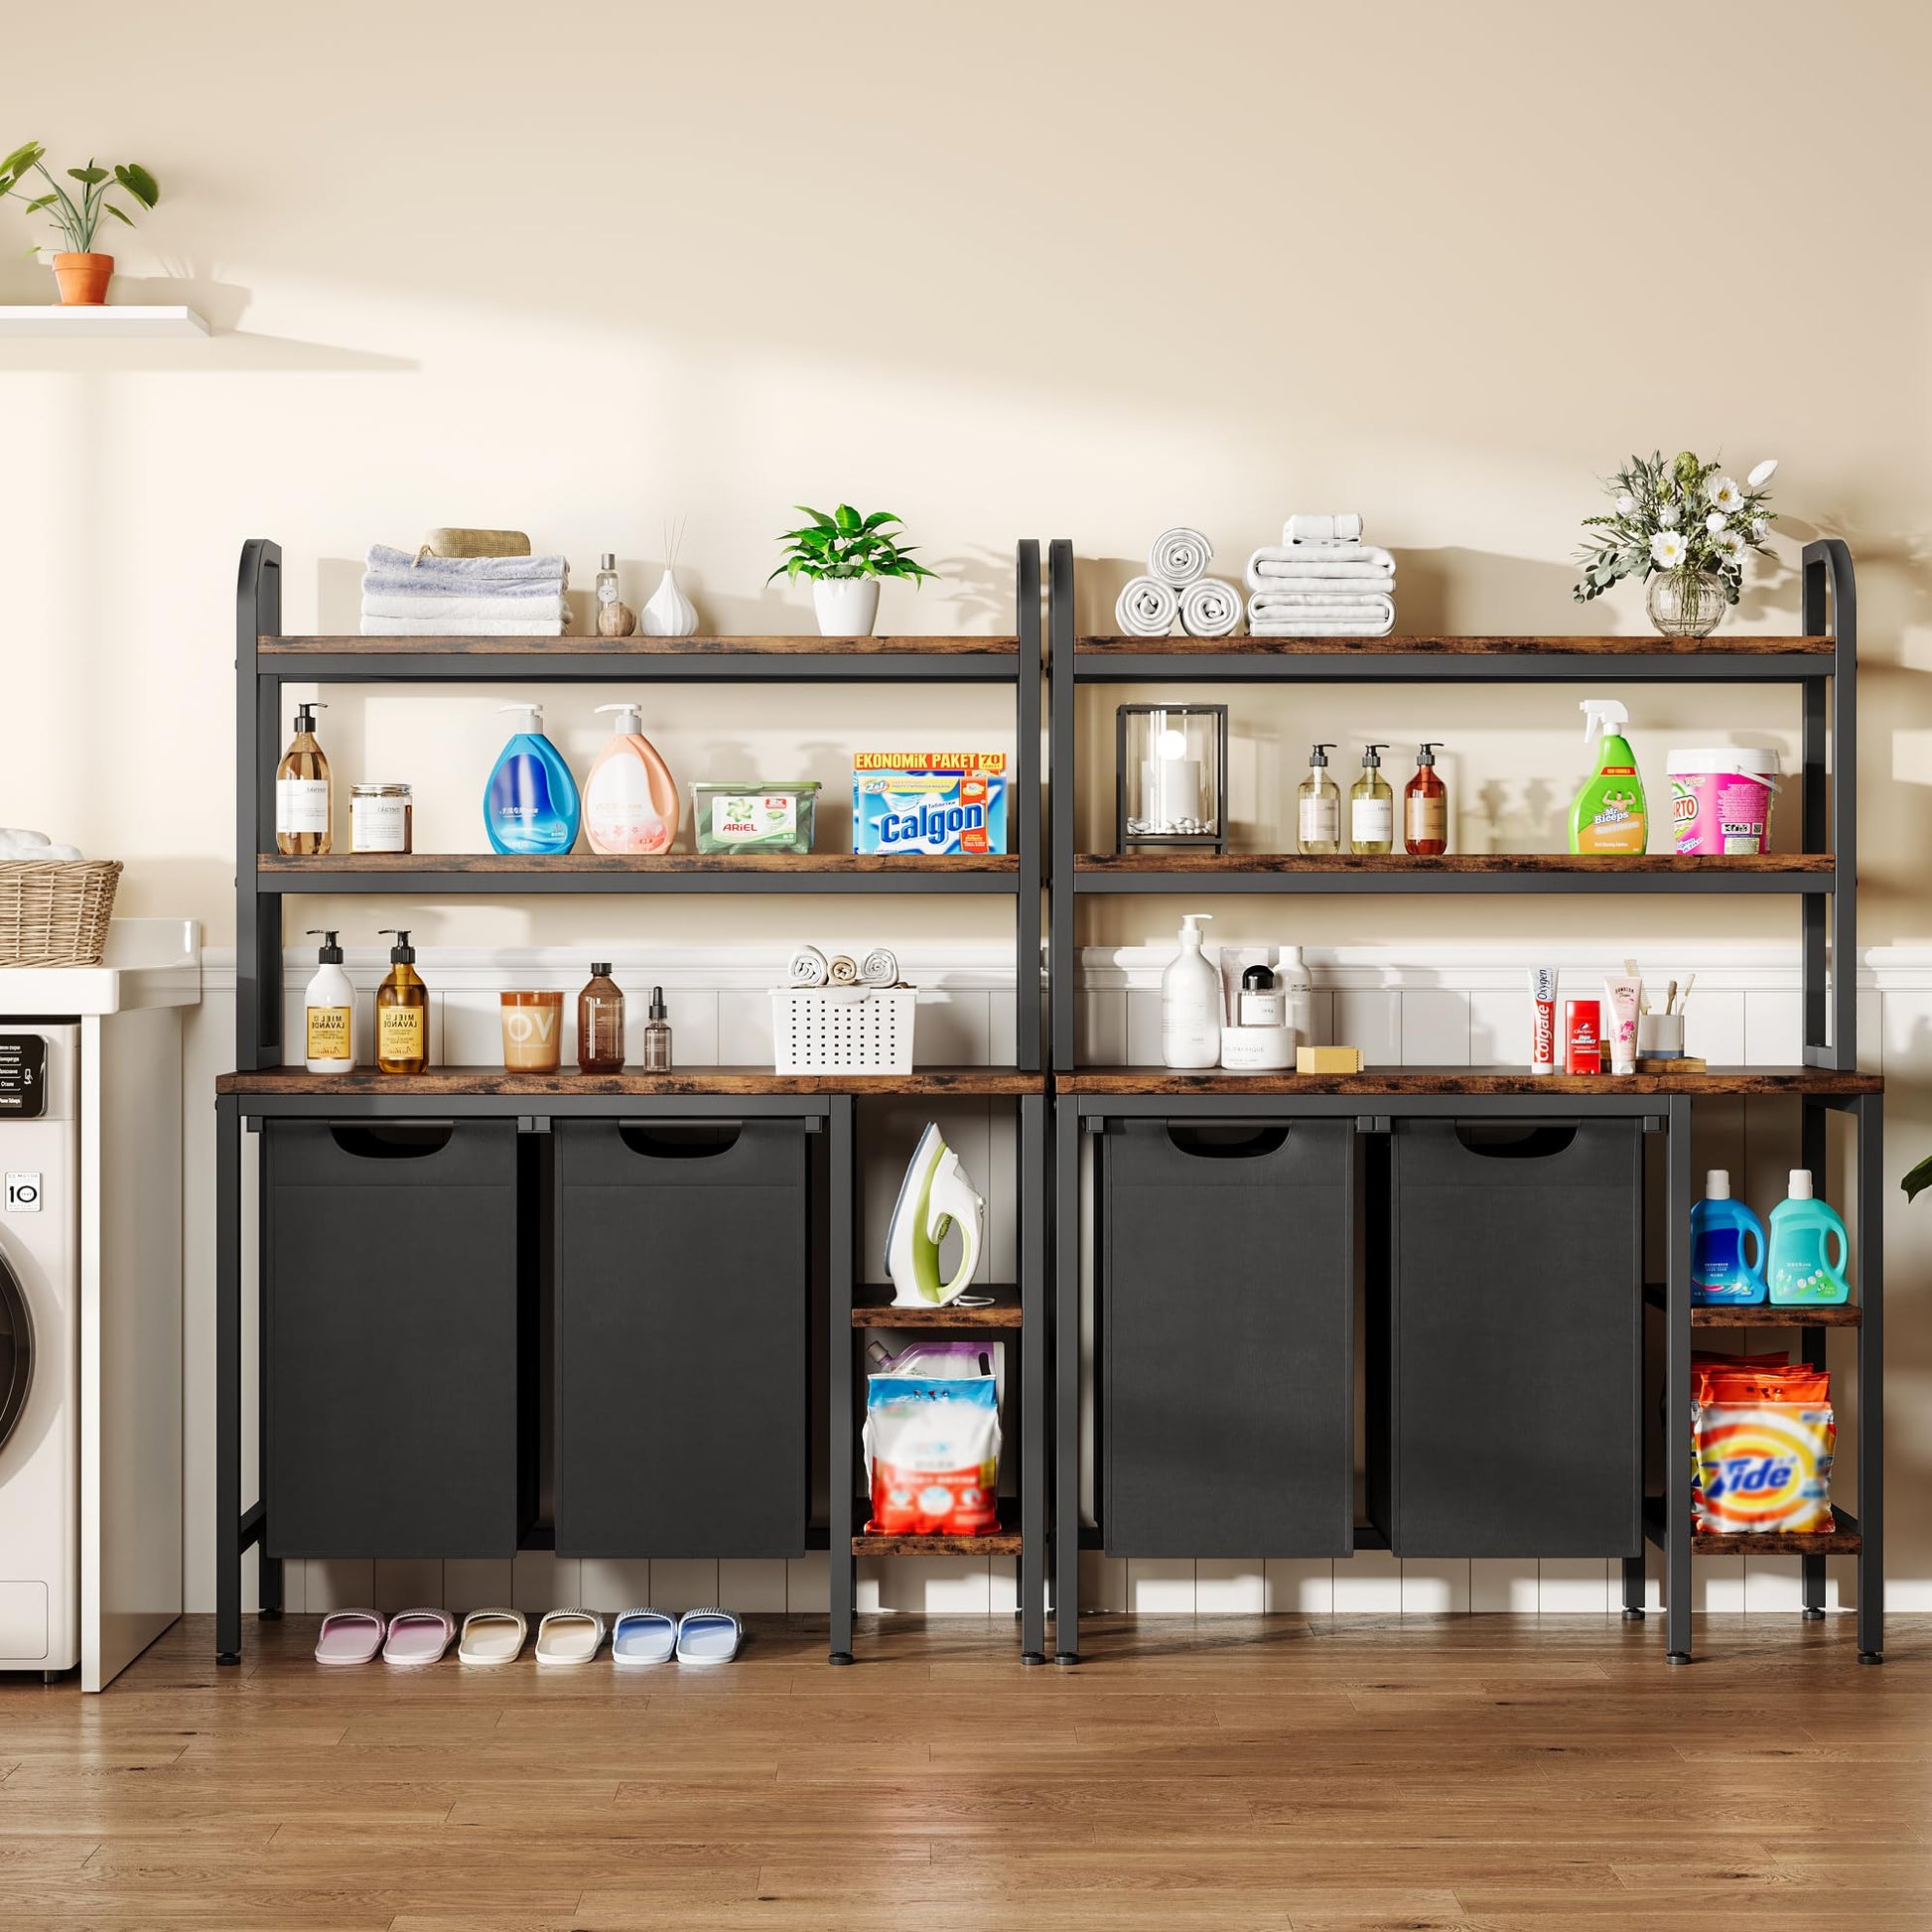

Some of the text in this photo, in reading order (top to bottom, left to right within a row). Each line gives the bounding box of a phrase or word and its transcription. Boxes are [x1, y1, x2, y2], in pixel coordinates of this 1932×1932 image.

[931, 753, 976, 768] PAKET
[981, 755, 1001, 764] 70
[881, 803, 985, 845] Calgon
[1594, 811, 1629, 825] Biceps
[1537, 969, 1549, 1000] Oxygen
[1534, 1004, 1553, 1062] Colgate
[9, 1185, 38, 1203] 10
[1700, 1457, 1792, 1499] Tide
